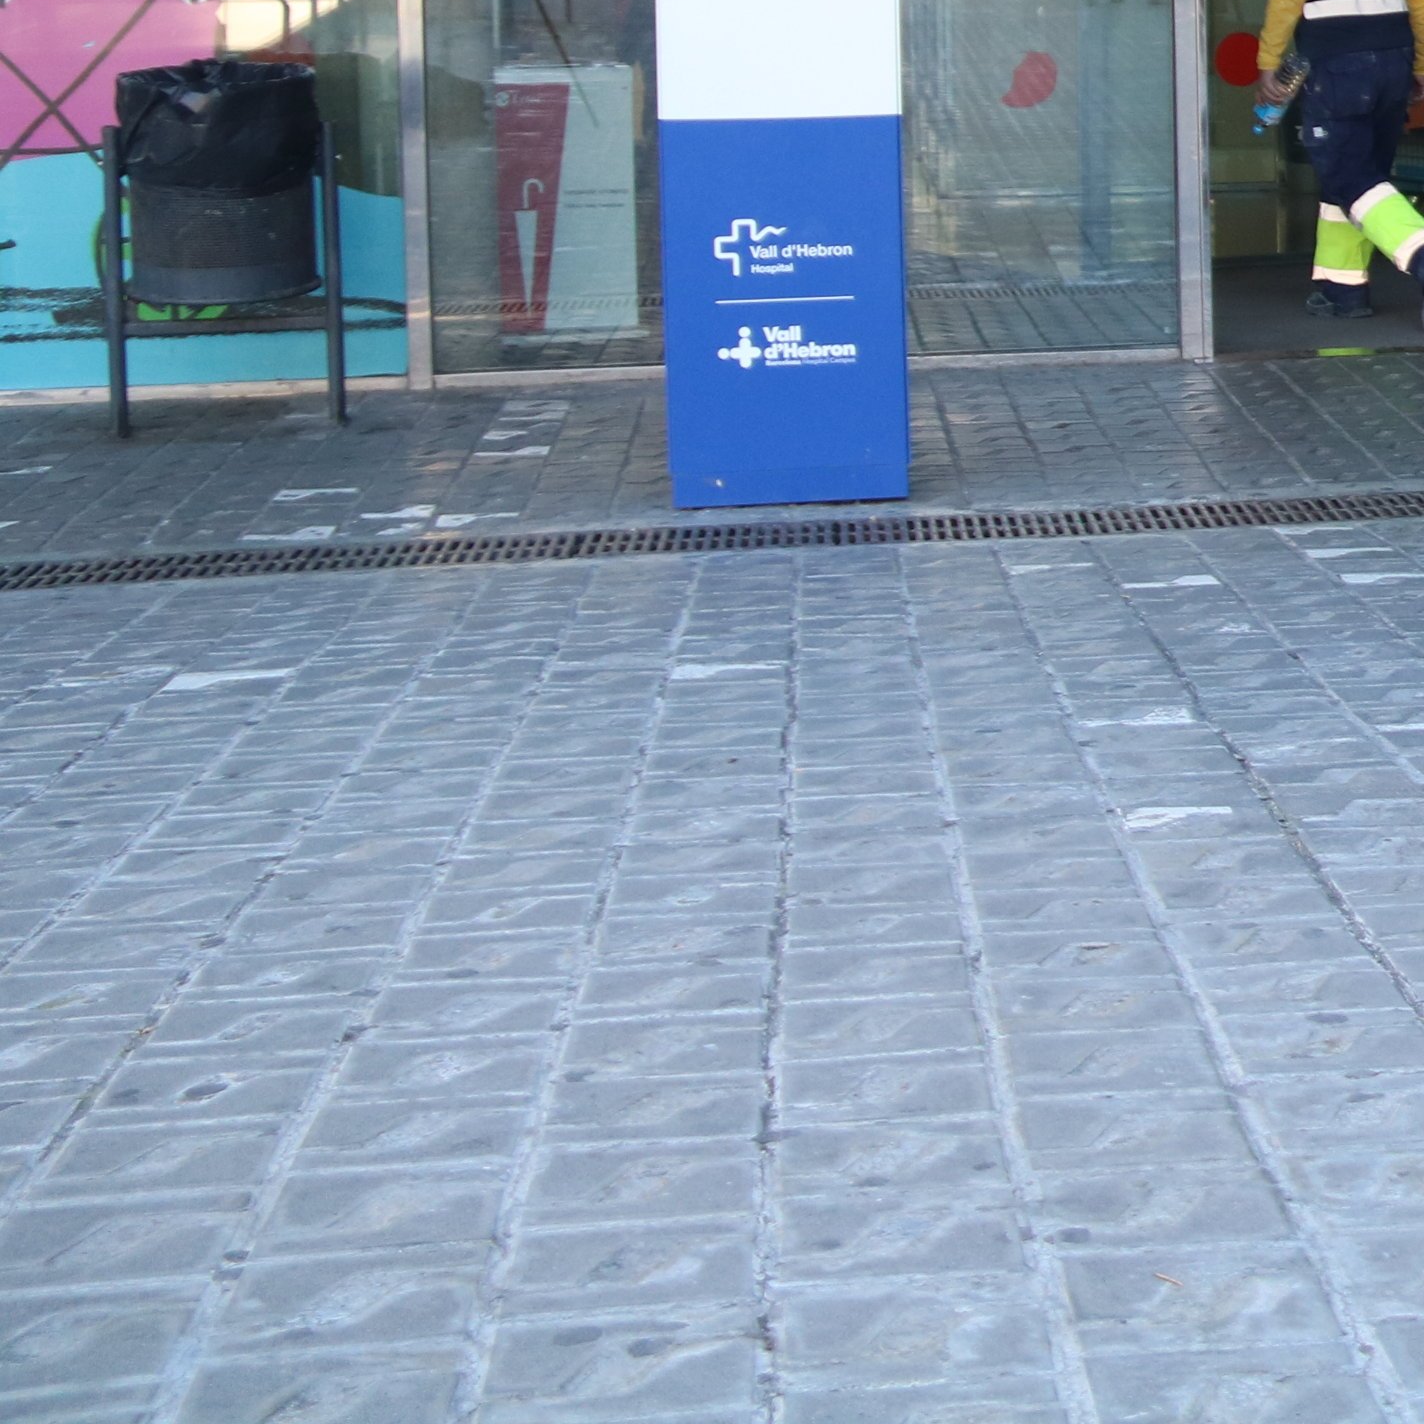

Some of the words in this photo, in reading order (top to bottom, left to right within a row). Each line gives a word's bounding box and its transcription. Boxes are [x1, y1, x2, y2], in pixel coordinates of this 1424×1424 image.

[749, 244, 778, 259] Vall
[781, 243, 854, 258] d'Hebron
[750, 262, 795, 275] Hospital
[762, 325, 802, 343] Vall
